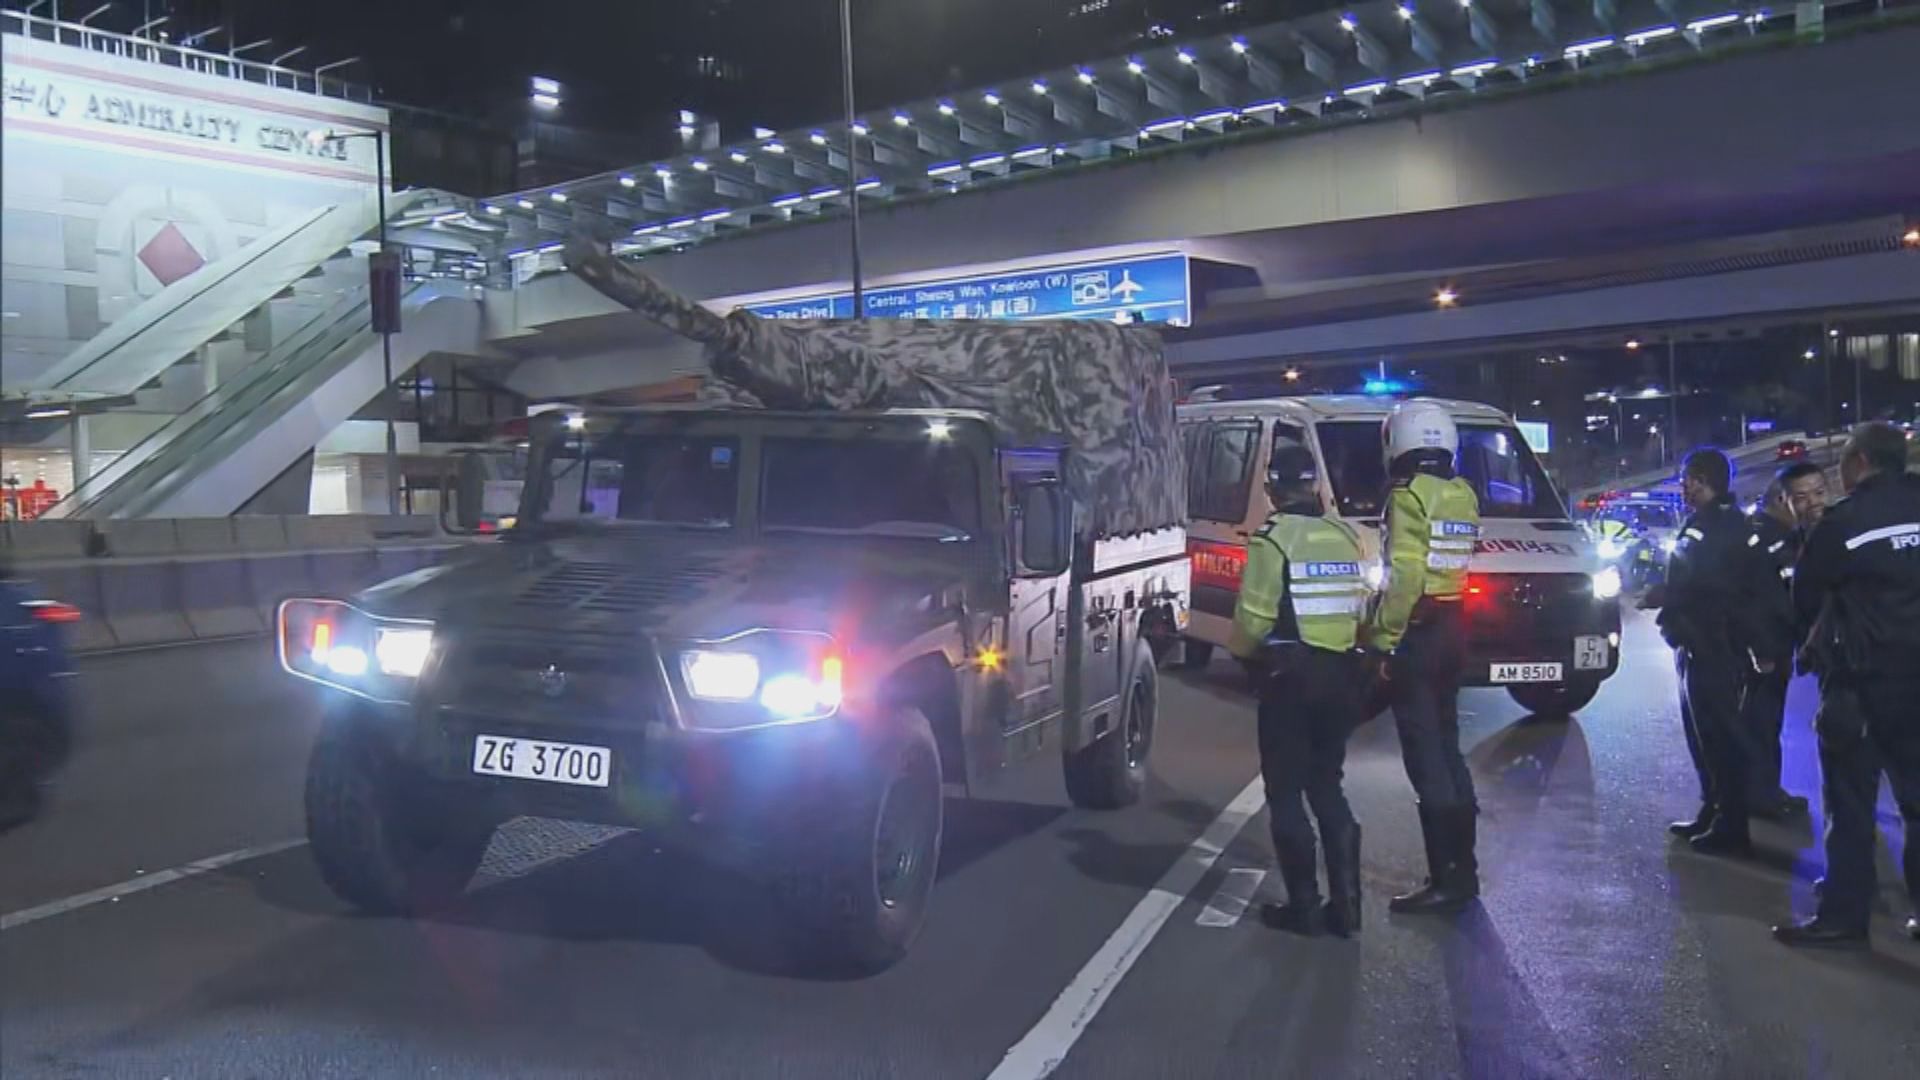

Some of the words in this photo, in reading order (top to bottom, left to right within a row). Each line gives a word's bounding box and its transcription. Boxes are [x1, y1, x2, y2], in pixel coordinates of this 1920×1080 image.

[84, 92, 241, 144] ADMIRALTY
[991, 278, 1041, 295] Kowloon
[1497, 667, 1517, 680] AM
[1521, 665, 1557, 680] 8510
[481, 740, 516, 773] ZG
[532, 745, 601, 781] 3700
